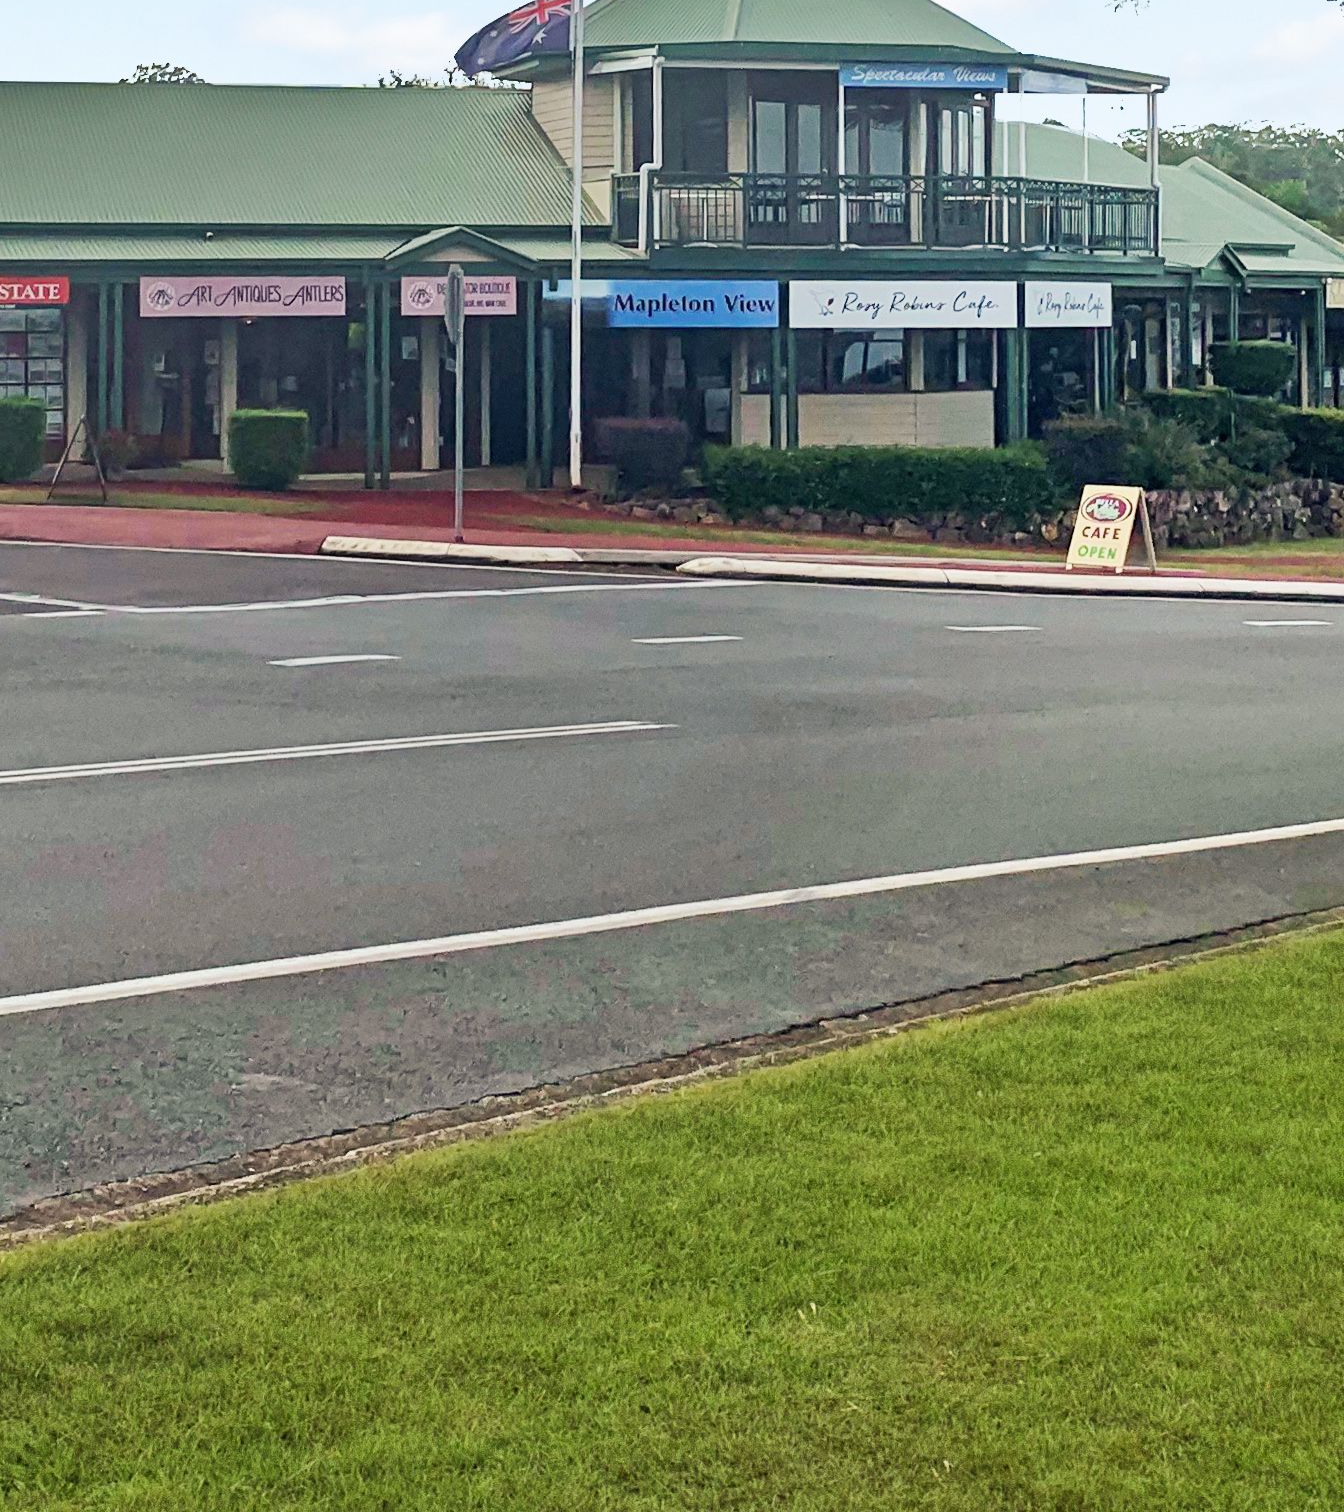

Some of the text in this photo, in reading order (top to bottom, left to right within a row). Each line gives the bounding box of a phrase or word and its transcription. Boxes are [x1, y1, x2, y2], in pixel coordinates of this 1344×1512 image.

[851, 65, 997, 84] Spectacular Views
[177, 285, 213, 307] ART
[613, 293, 776, 318] Mapleton View
[1082, 526, 1122, 540] CAFE
[1077, 544, 1118, 560] OPEN
